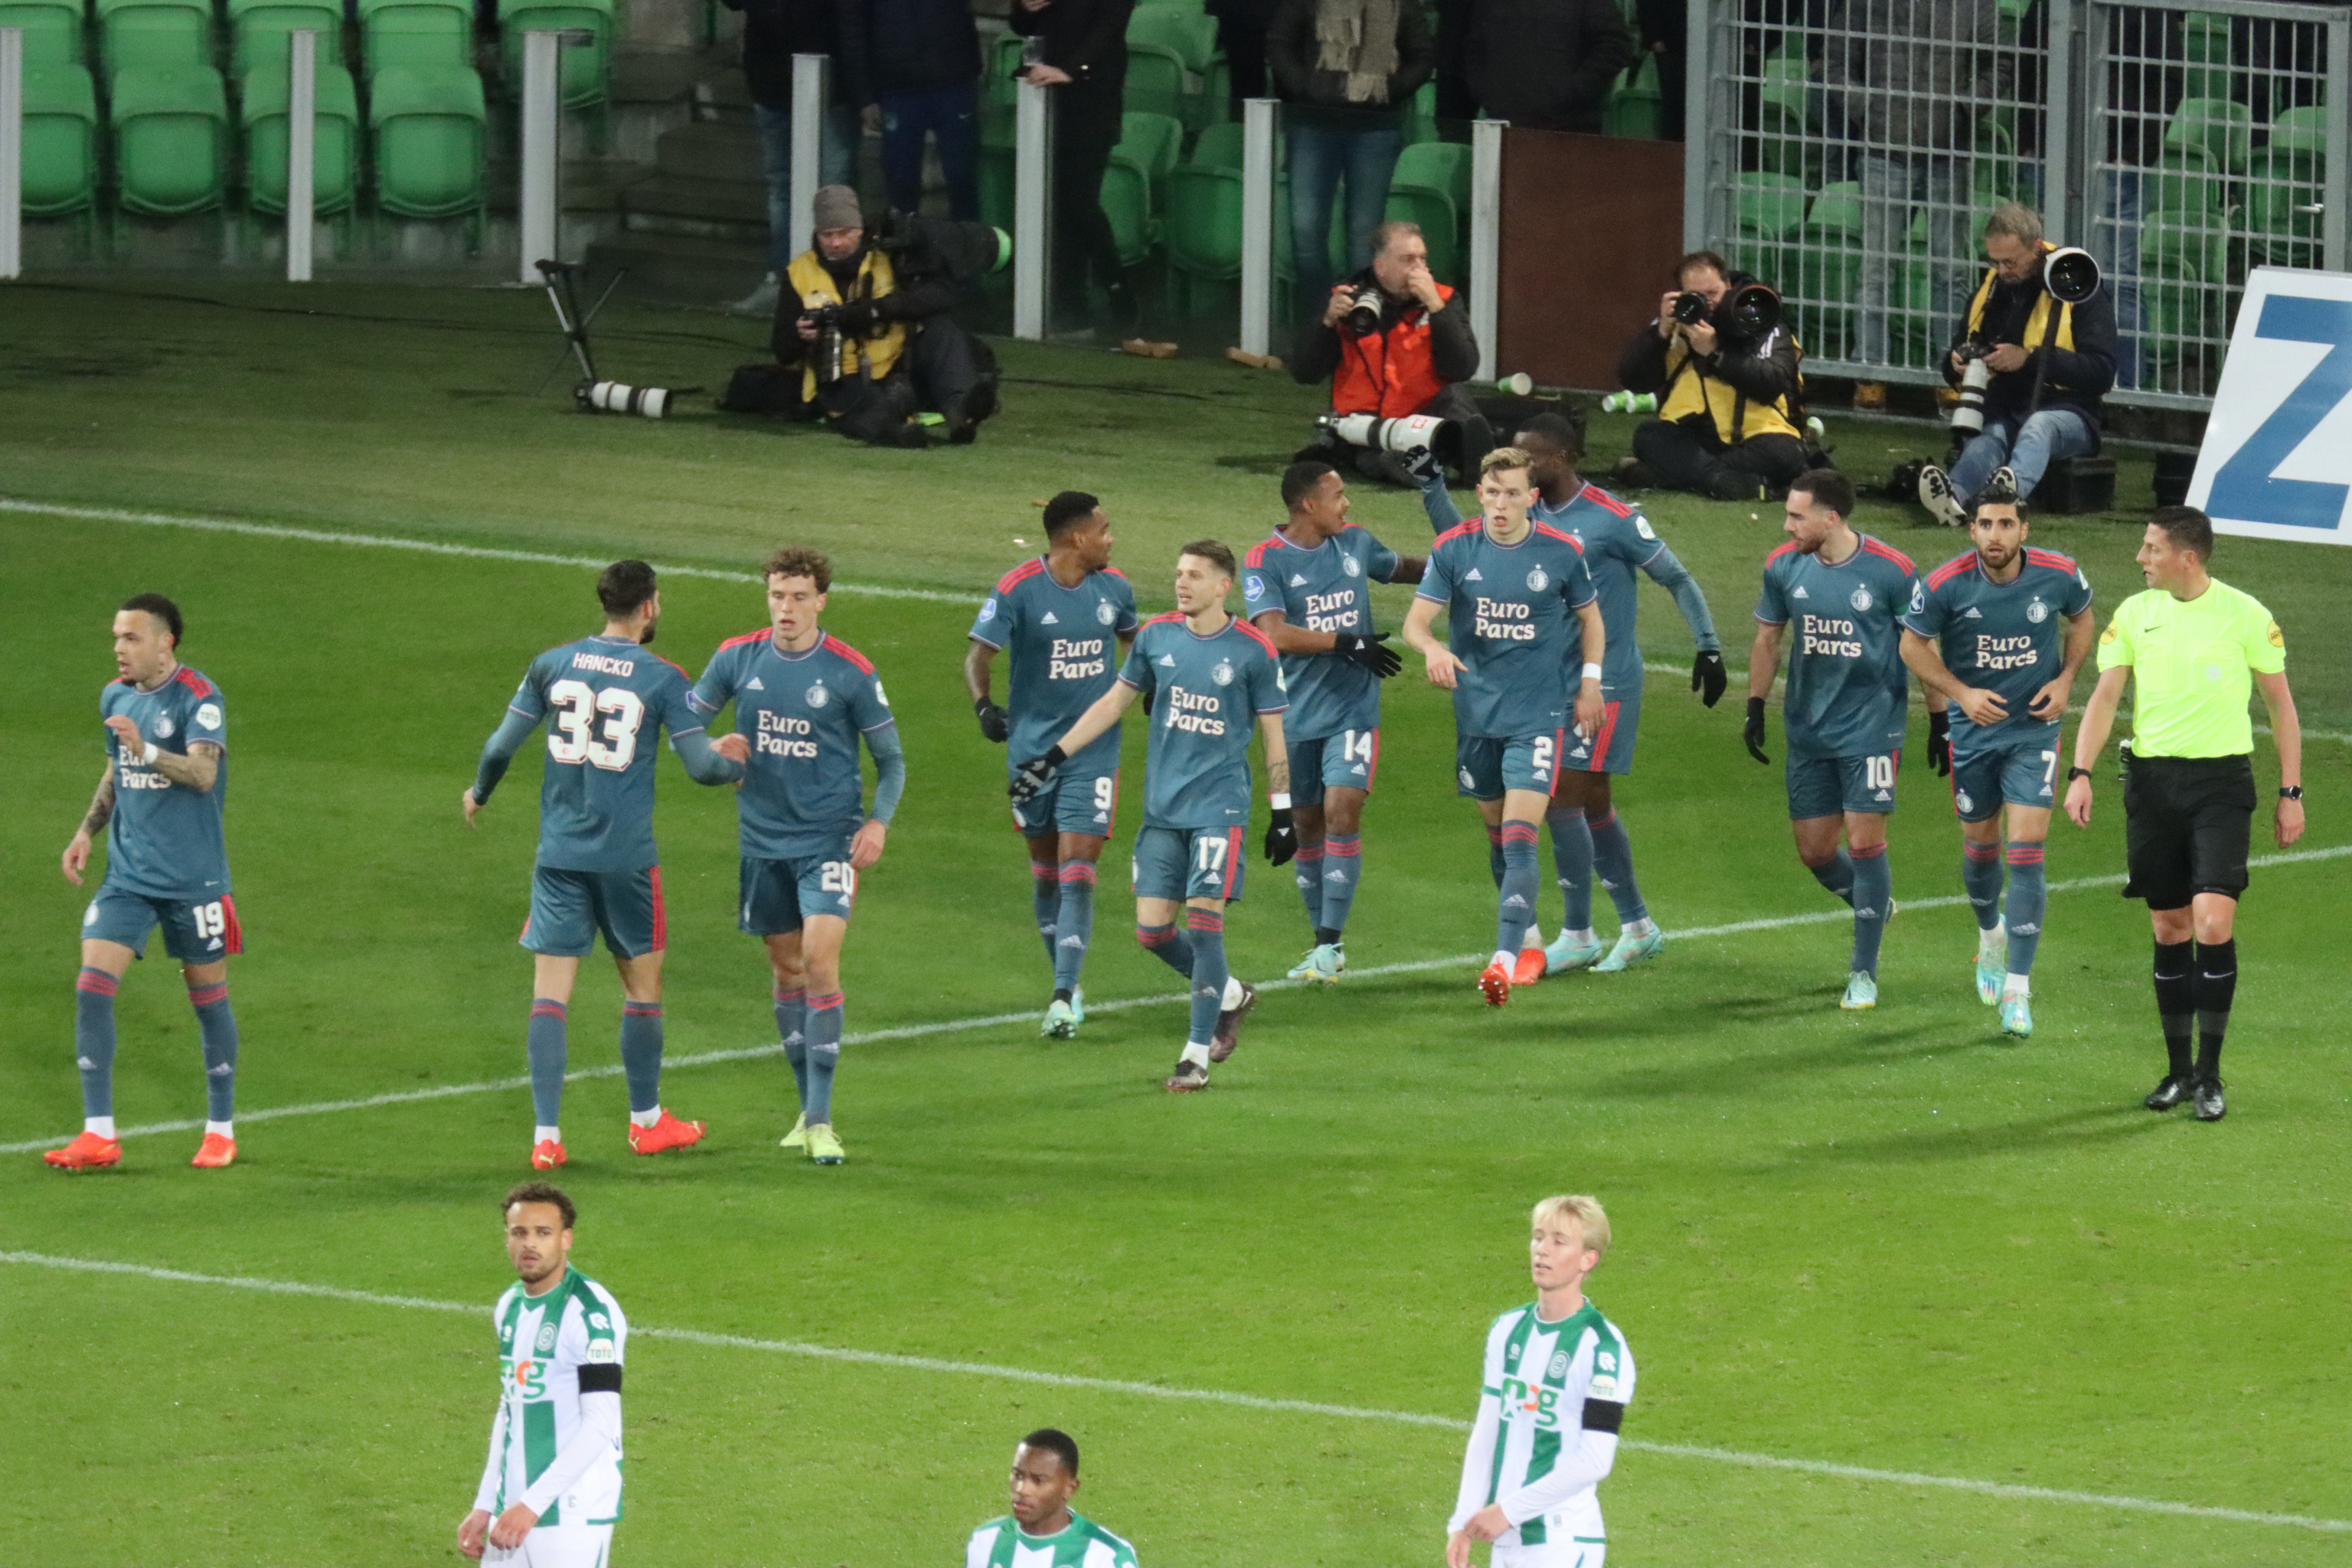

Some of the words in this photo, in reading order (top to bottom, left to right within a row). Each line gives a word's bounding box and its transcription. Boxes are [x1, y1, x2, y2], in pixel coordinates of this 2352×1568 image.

[2205, 293, 2352, 530] Z
[1305, 589, 1355, 619] Euro
[1476, 597, 1529, 620] Euro
[1305, 609, 1359, 632] Parcs
[1475, 617, 1536, 641] Parcs
[1803, 614, 1853, 638] Euro
[1051, 639, 1103, 658] Euro
[1803, 635, 1862, 657] Parcs
[1977, 635, 2031, 652] Euro
[571, 651, 635, 677] HANCKO
[1049, 658, 1105, 679] Parcs
[1976, 647, 2037, 669] Parcs
[1169, 685, 1219, 714] Euro
[548, 678, 645, 772] 33
[757, 709, 810, 737] Euro
[1164, 705, 1225, 736] Parcs
[118, 745, 146, 767] Eu
[756, 732, 817, 758] Parcs
[1343, 729, 1373, 764] 14
[1532, 736, 1554, 769] 2
[119, 767, 170, 790] Parcs
[1866, 756, 1893, 790] 10
[2041, 750, 2057, 783] 7
[1094, 776, 1114, 811] 9
[1198, 836, 1229, 871] 17
[821, 861, 854, 895] 20
[192, 901, 224, 940] 19
